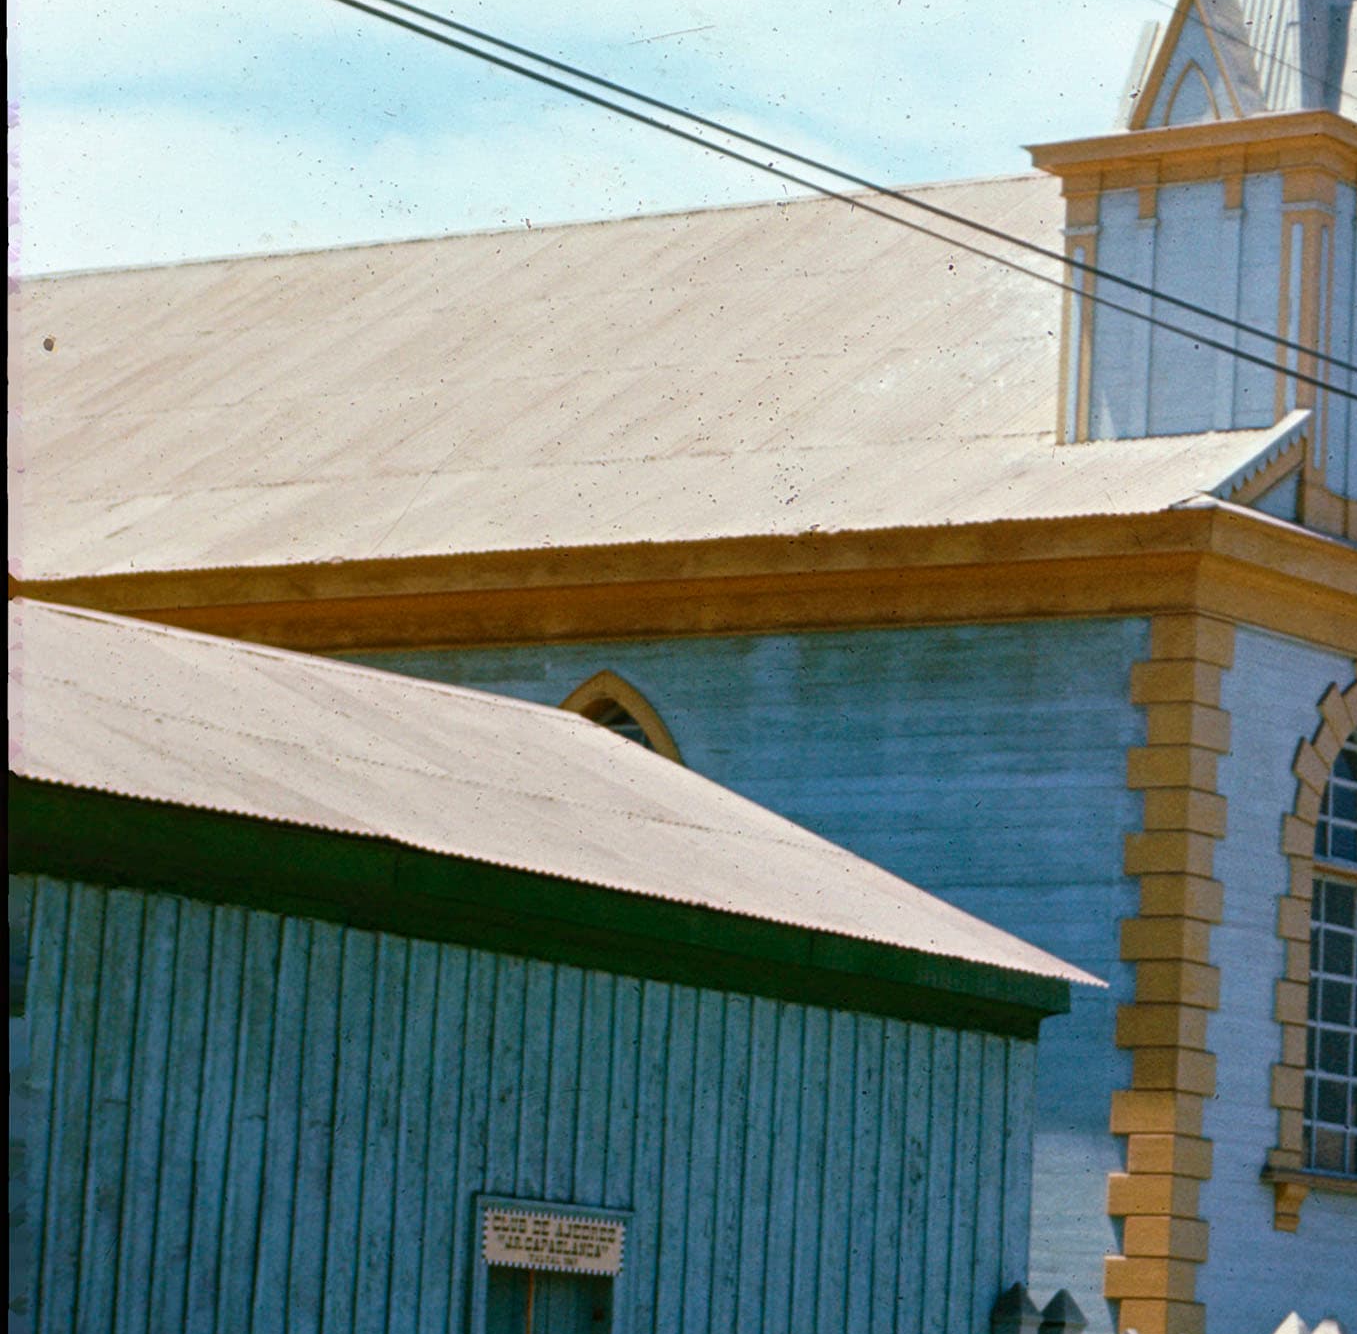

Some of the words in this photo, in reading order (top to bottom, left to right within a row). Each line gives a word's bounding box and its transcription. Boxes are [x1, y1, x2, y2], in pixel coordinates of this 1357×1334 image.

[493, 1215, 527, 1234] CLUB
[532, 1219, 550, 1236] DE
[555, 1222, 616, 1244] AJEDREZ
